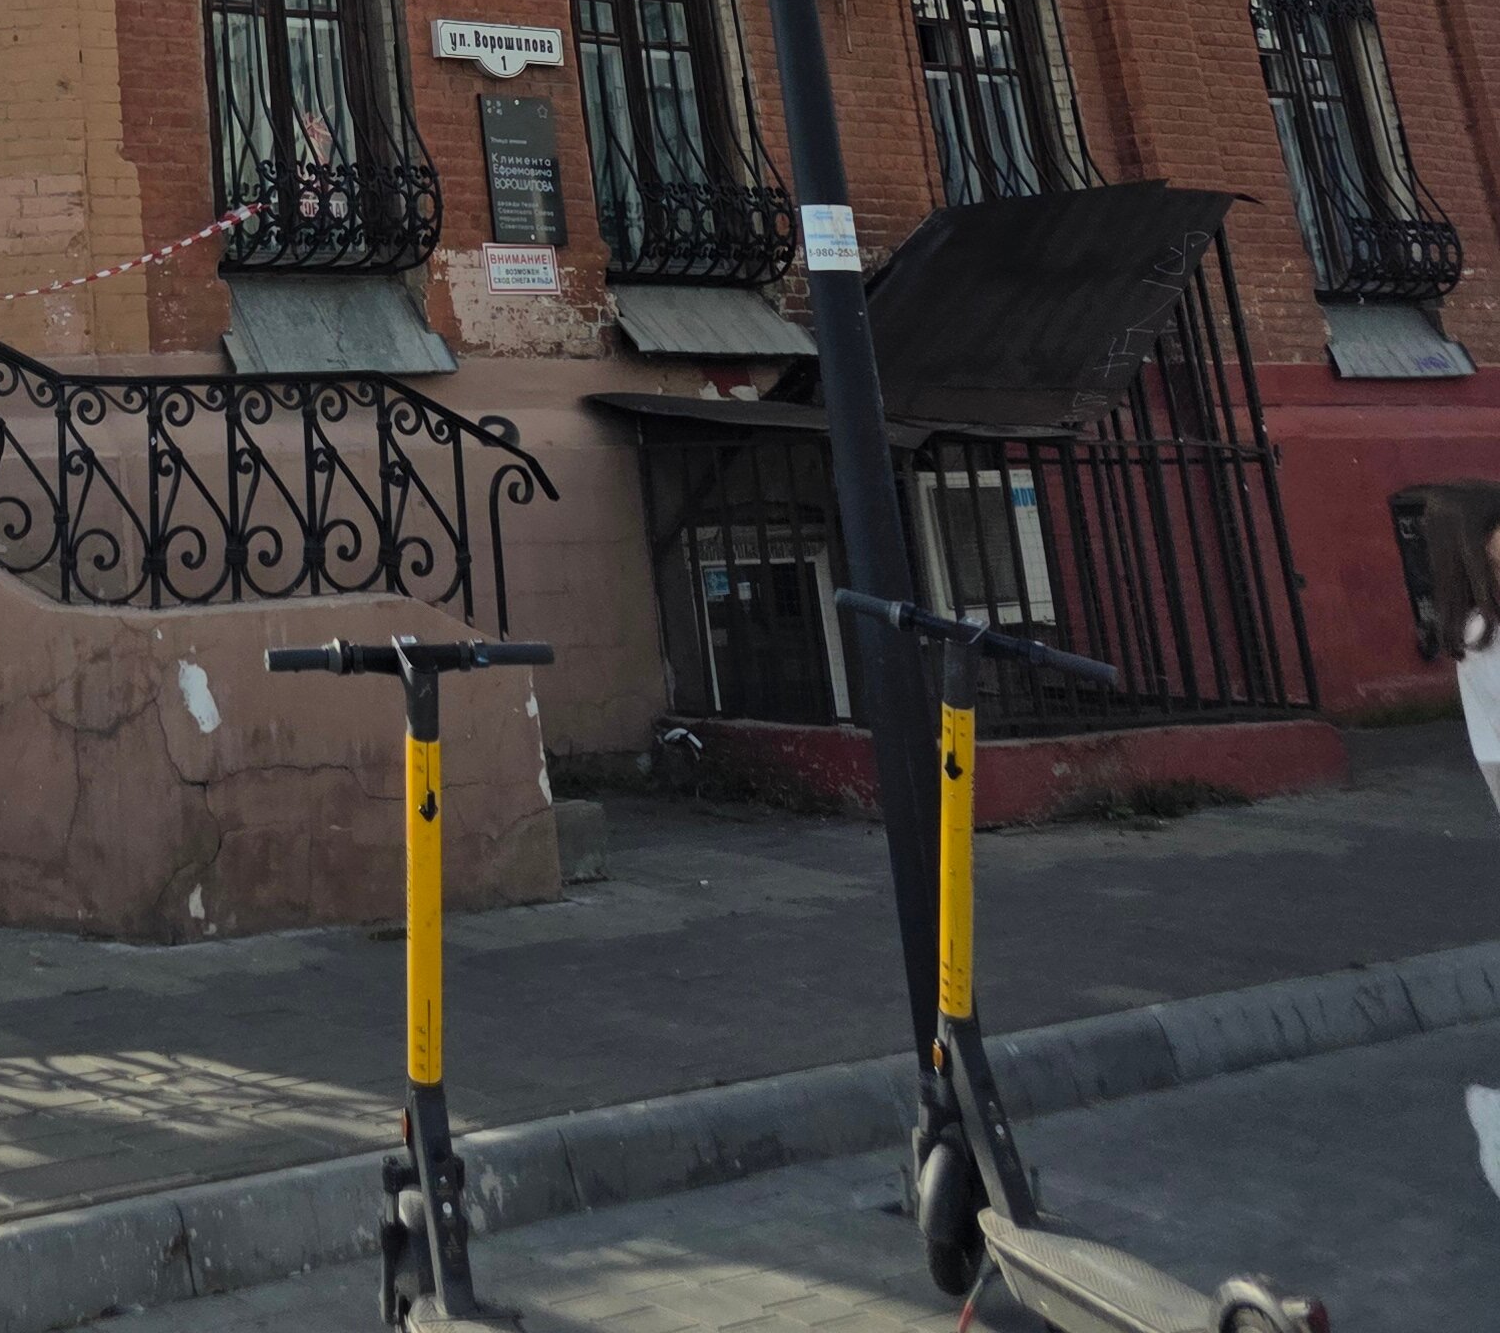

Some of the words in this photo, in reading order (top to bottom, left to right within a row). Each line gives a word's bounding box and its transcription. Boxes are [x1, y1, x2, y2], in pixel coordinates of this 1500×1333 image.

[449, 32, 471, 51] ул.
[473, 30, 554, 54] Ворошилова
[501, 55, 507, 71] 1
[491, 153, 552, 167] Климента
[492, 164, 553, 178] Ефремовича
[494, 177, 555, 192] ВОРОШИЛОВА
